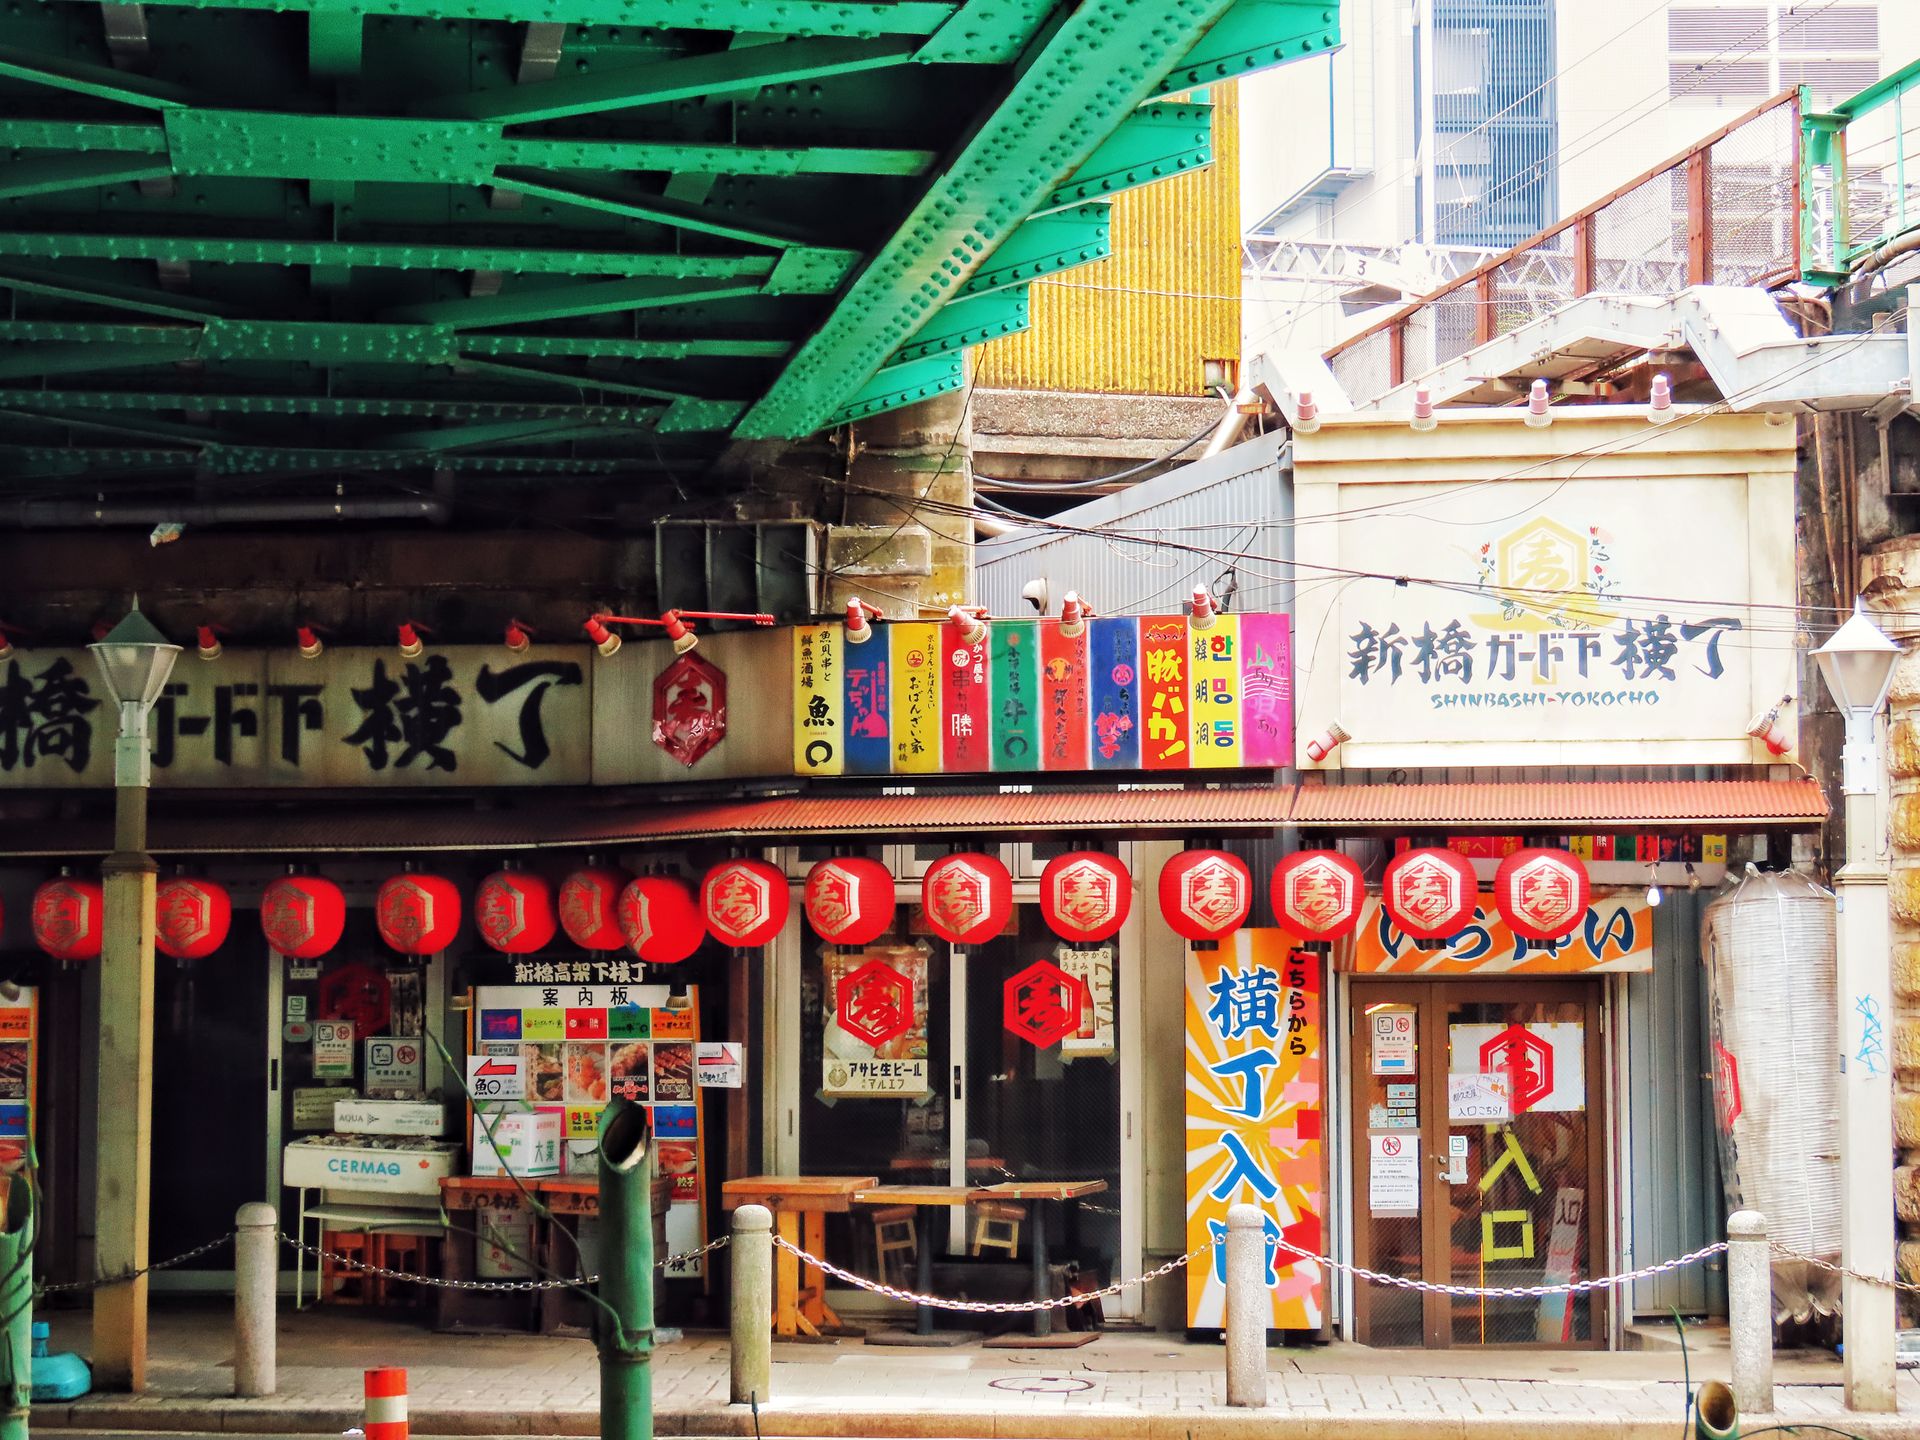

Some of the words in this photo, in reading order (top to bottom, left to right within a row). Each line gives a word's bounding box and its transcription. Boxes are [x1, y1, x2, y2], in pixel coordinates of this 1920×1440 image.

[1357, 259, 1366, 275] 3
[1348, 614, 1742, 686] 新橋ガード下横丁
[801, 634, 814, 688] 鮮魚酒場
[1195, 636, 1209, 747] 韓明洞
[1430, 690, 1660, 710] SHINBASHI-YOKOCHO
[908, 676, 925, 754] おばんざい家
[1063, 951, 1109, 960] まろやかな
[514, 962, 647, 983] 新橋高架下横丁
[1063, 963, 1088, 972] うまみ
[1287, 946, 1308, 1056] こちらから
[849, 1063, 922, 1077] アサヒ生ビール
[868, 1079, 905, 1090] マルエフ
[328, 1159, 400, 1176] CERMAQ
